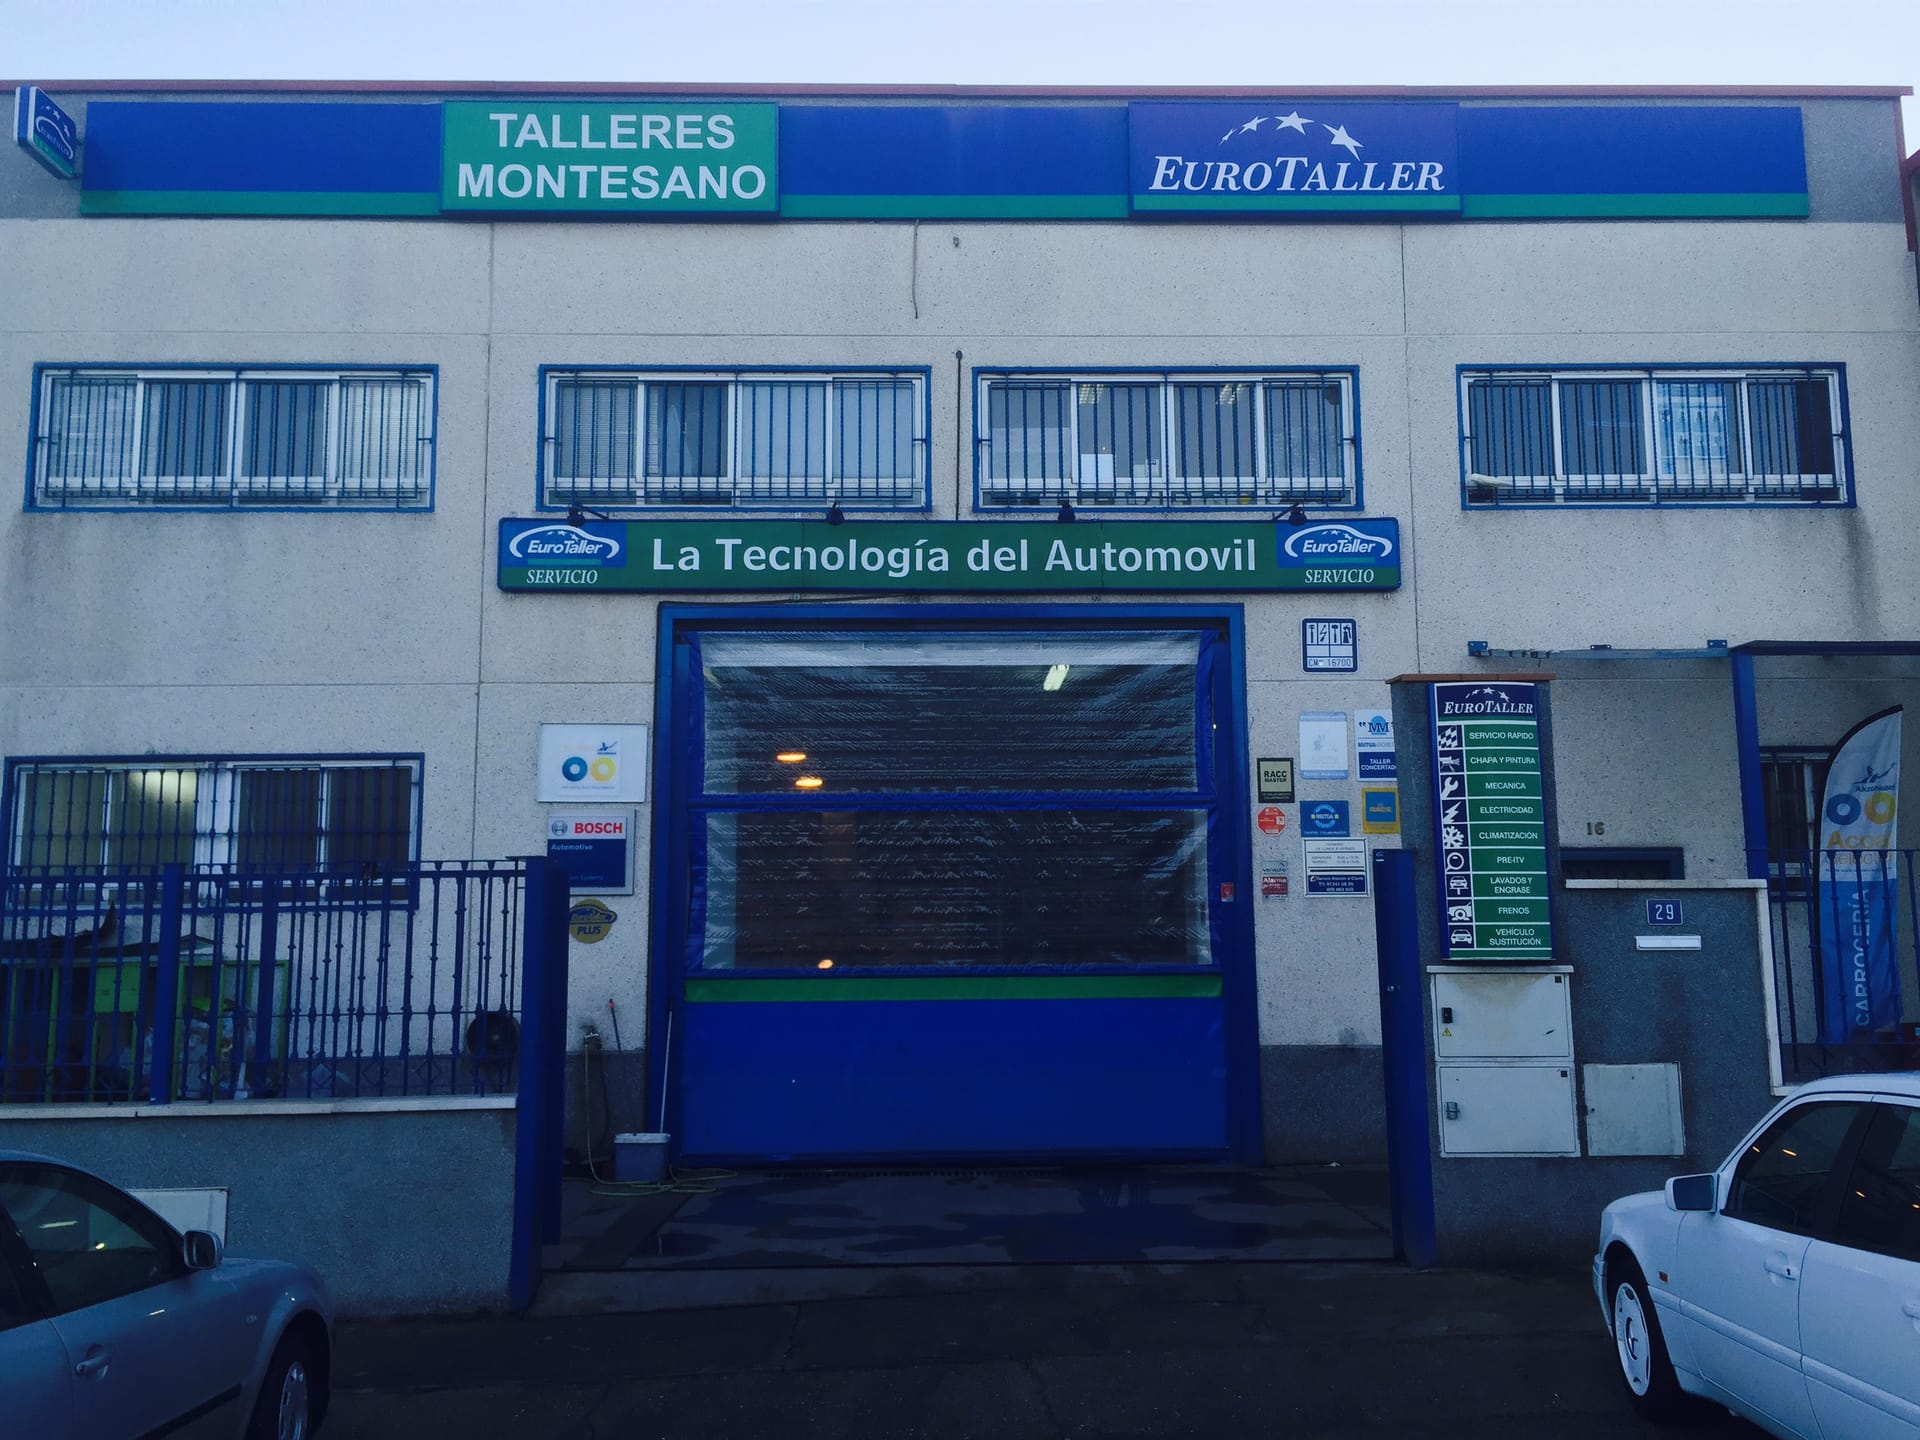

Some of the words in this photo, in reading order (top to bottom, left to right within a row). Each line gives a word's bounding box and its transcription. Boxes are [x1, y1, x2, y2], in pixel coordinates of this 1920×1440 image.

[489, 113, 735, 150] TALLERES
[458, 163, 766, 200] MONTESANO
[527, 540, 603, 555] EuroTaller
[1302, 538, 1377, 555] EuroTaller
[652, 538, 700, 571] La
[716, 538, 949, 578] Tecnología
[967, 539, 1028, 572] del
[1045, 539, 1256, 572] Automovil
[526, 569, 598, 585] SERVICIO
[1304, 569, 1375, 584] SERVICIO
[1469, 731, 1506, 740] SERVICIO
[1507, 732, 1534, 740] RAPIDO
[1469, 756, 1498, 765] CHAPA
[1498, 756, 1505, 764] Y
[1505, 756, 1536, 764] PINTURA
[1263, 770, 1287, 778] RACC
[1485, 782, 1526, 790] MECANICA
[1480, 806, 1534, 814] ELECTRICIDAD
[574, 822, 623, 834] BOSCH
[1478, 831, 1539, 840] CLIMATIZACION
[551, 843, 593, 851] Automotive
[1496, 856, 1525, 864] PRE-ITV
[1494, 886, 1531, 894] ENGRASE
[1498, 907, 1530, 915] FRENOS
[1655, 904, 1674, 921] 29
[576, 925, 601, 936] PLUS
[1495, 928, 1535, 936] VEHÍCULO
[1489, 937, 1542, 946] SUSTITUCIÓN
